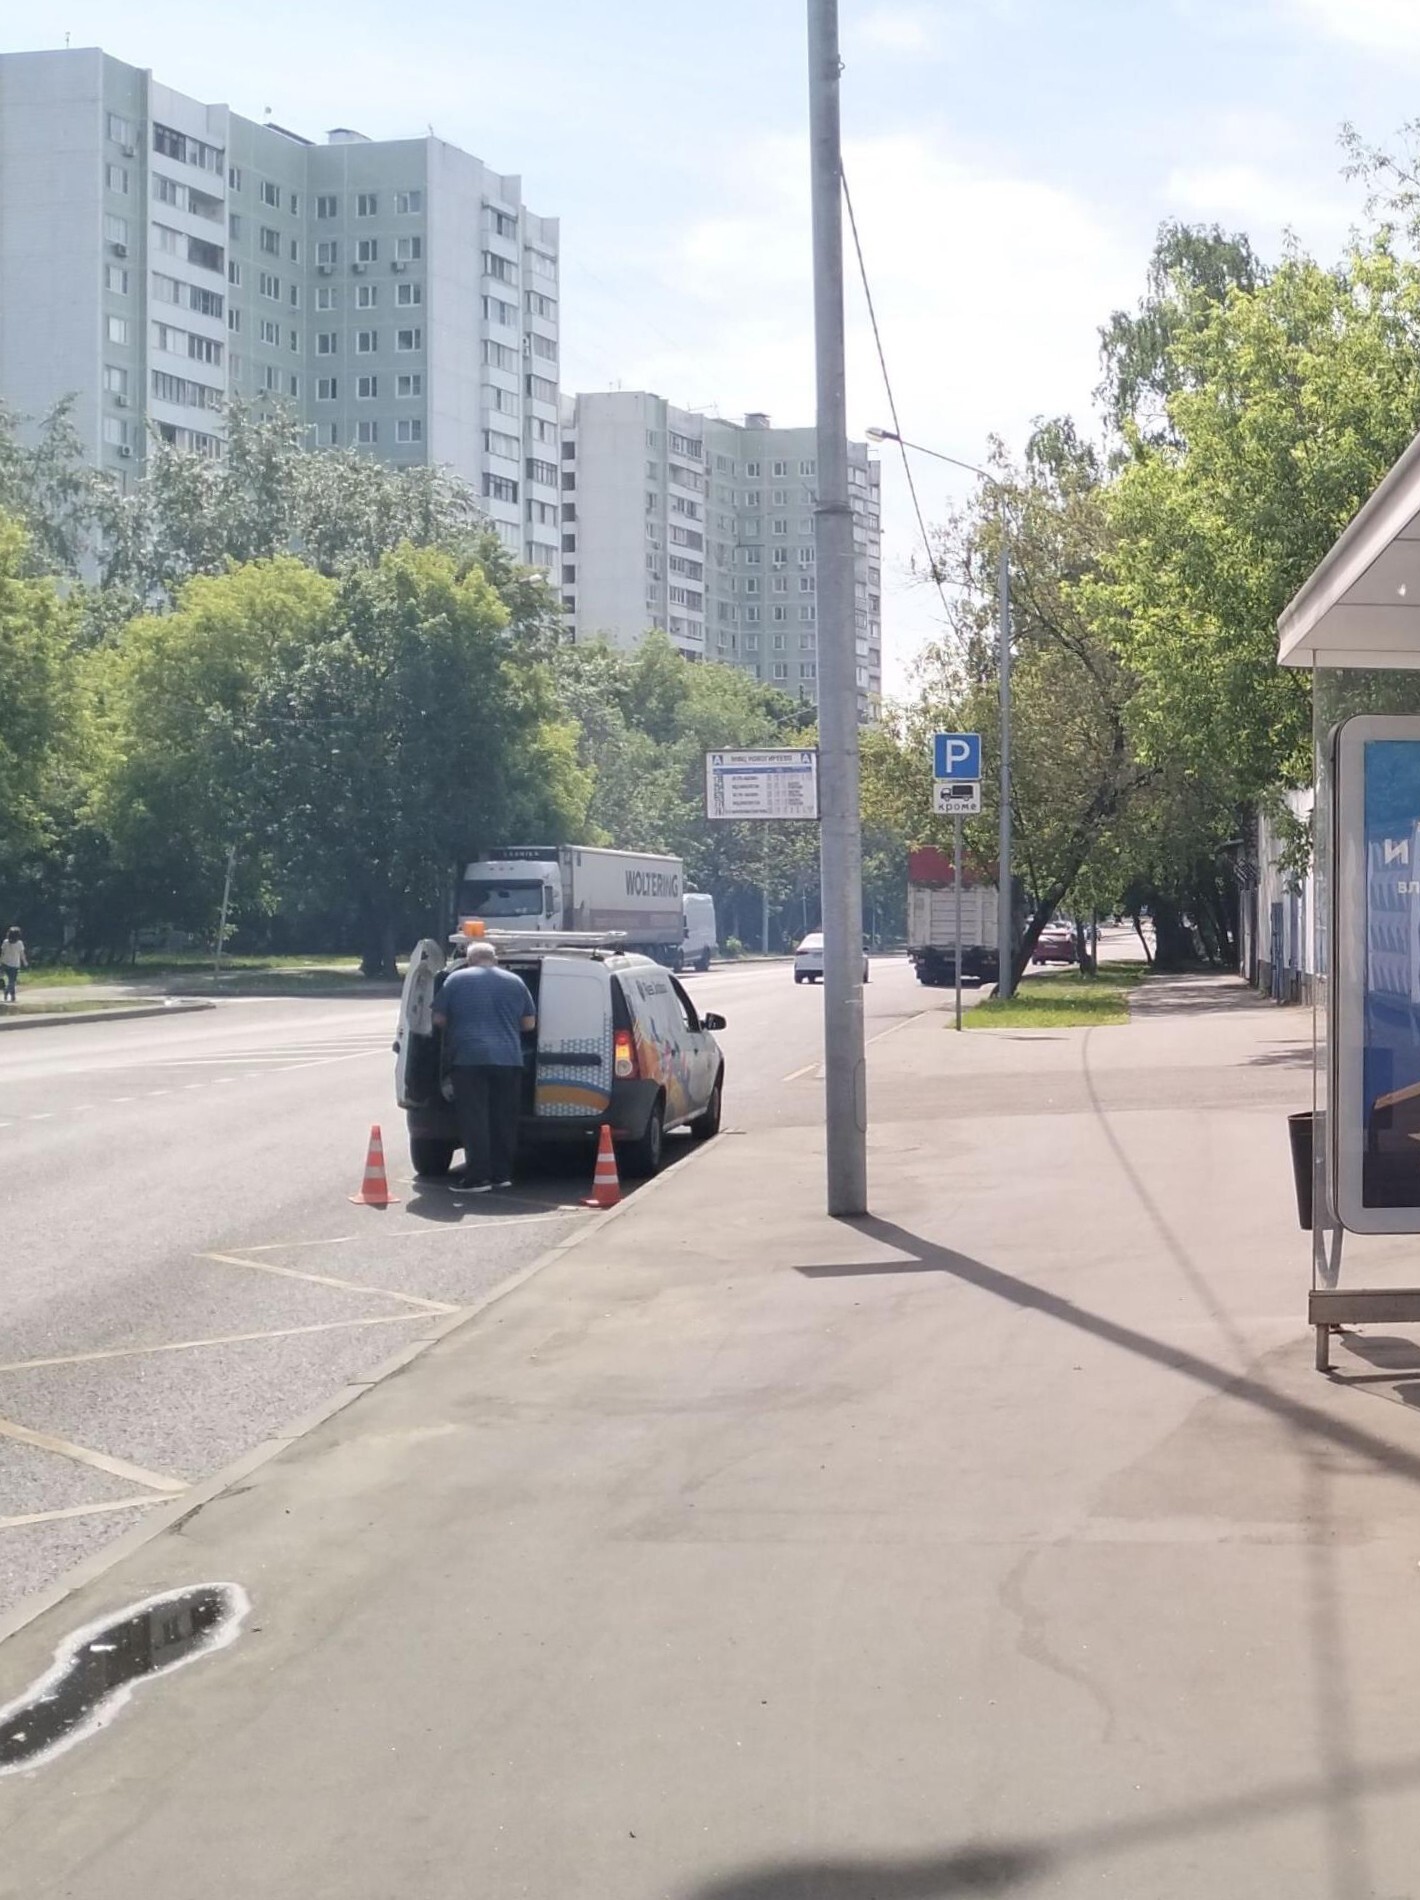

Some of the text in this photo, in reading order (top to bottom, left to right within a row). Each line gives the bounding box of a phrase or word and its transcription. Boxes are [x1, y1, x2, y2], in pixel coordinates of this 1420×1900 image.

[946, 739, 970, 773] P
[939, 803, 977, 812] кроме
[1384, 838, 1409, 864] И
[625, 870, 678, 898] WOLTERING
